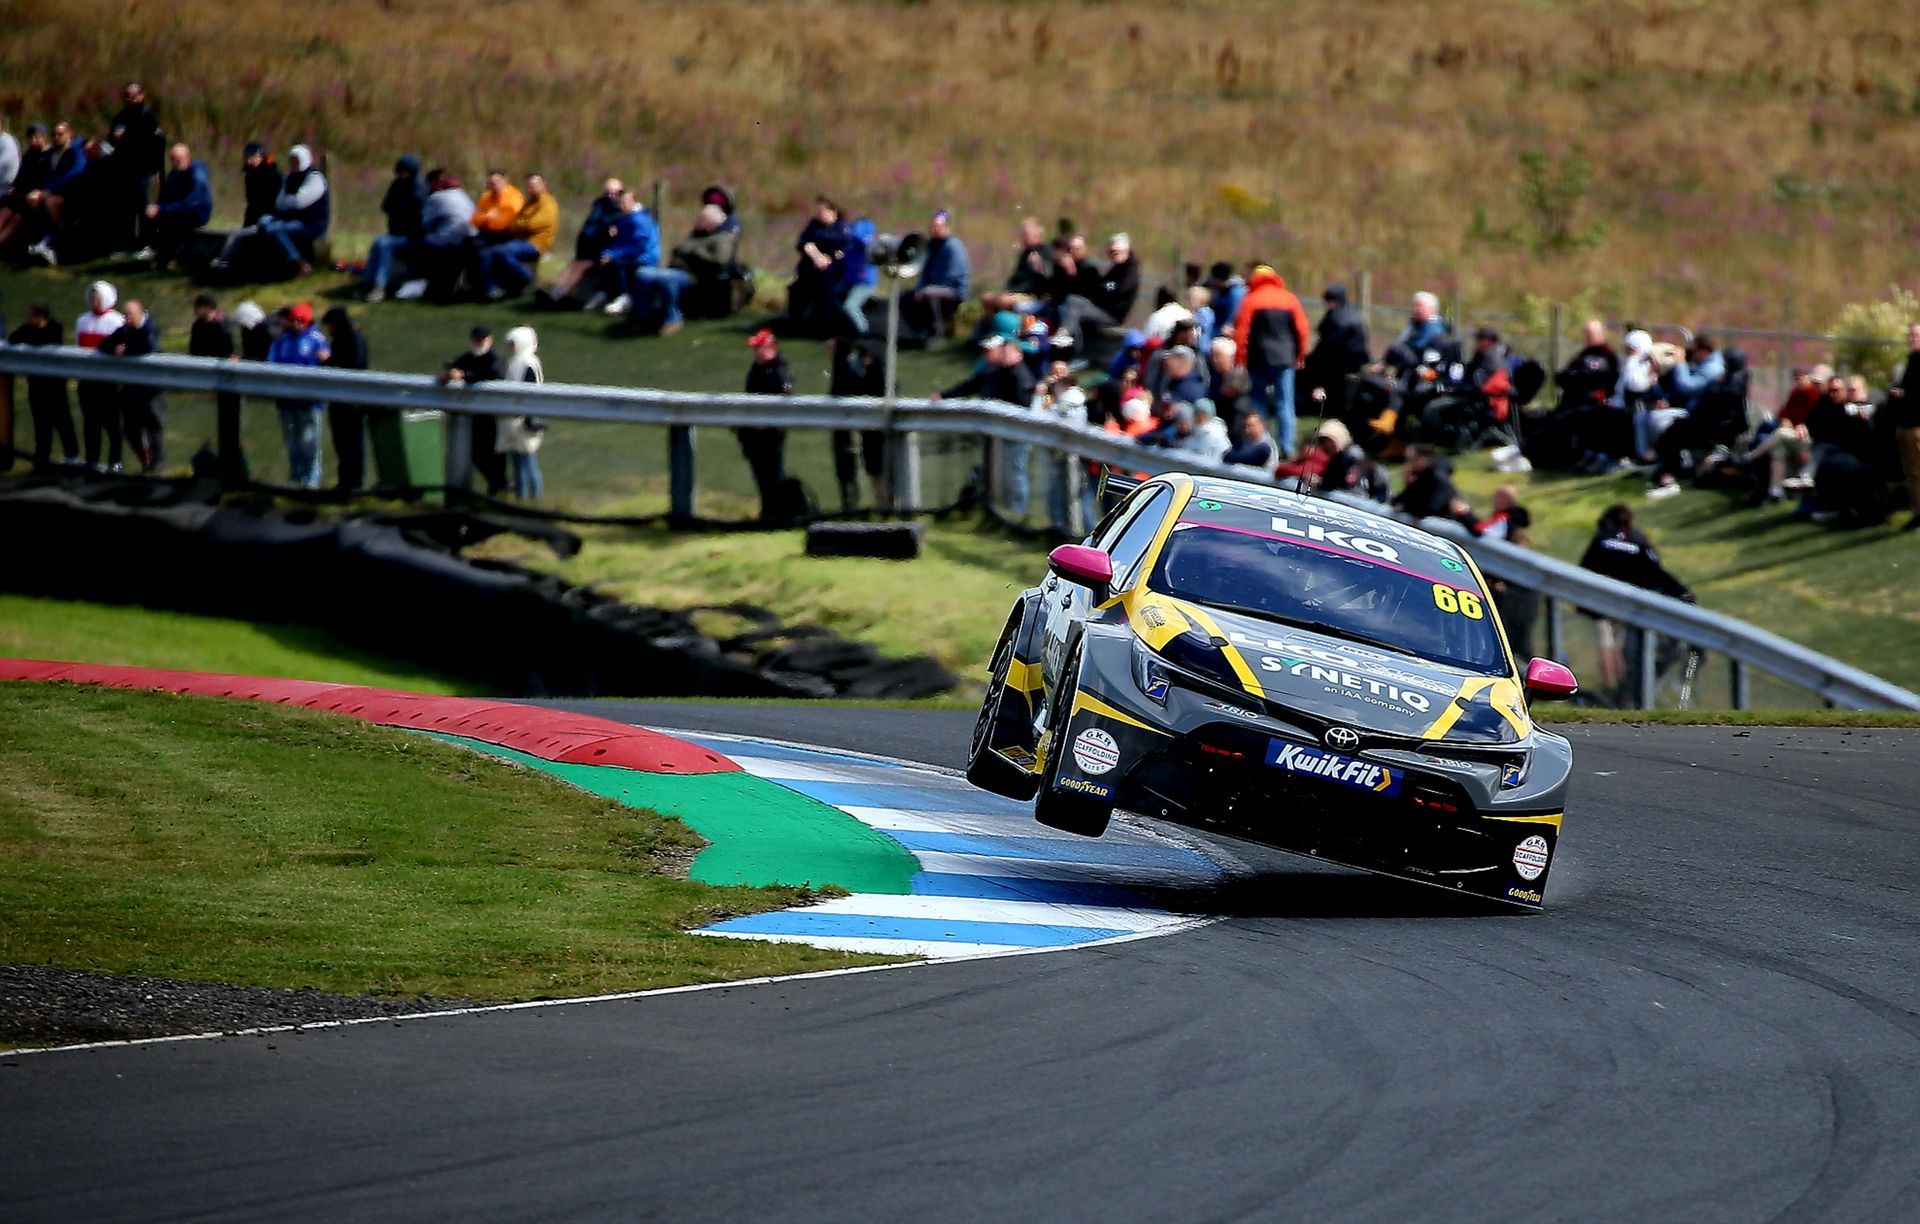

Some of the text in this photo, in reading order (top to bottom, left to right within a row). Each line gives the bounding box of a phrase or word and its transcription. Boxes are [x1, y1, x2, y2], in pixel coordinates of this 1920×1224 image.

[1271, 516, 1403, 565] LKQ
[1432, 583, 1484, 620] 66
[1229, 631, 1360, 667] LKQ
[1260, 656, 1430, 713] SYNETIQ
[1324, 686, 1416, 718] an IAA company
[1075, 740, 1118, 763] SCAFFOLDING
[1086, 731, 1112, 747] GKR
[1078, 757, 1106, 771] LIMITED
[1060, 777, 1109, 797] GOODYEAR
[1515, 851, 1546, 864] SCAFFOLDING
